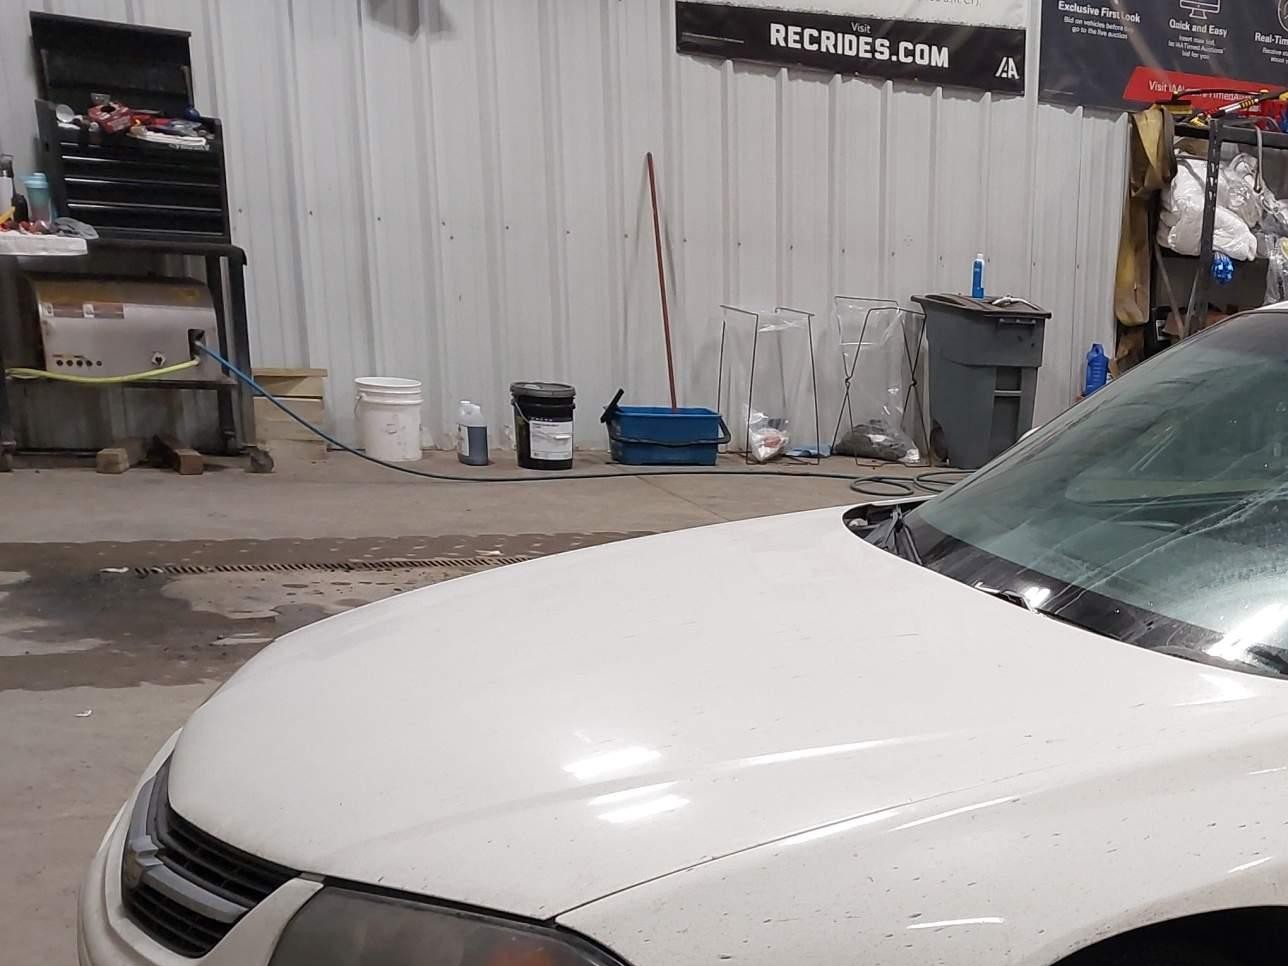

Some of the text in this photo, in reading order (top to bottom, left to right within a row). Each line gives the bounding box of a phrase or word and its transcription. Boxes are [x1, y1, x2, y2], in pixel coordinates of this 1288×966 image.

[1058, 1, 1100, 16] Exclusive
[1101, 7, 1120, 20] First
[851, 21, 872, 34] Visit
[1169, 18, 1228, 38] Quick and Easy
[769, 22, 949, 68] RECRIDES.COM
[1148, 79, 1167, 92] Visit
